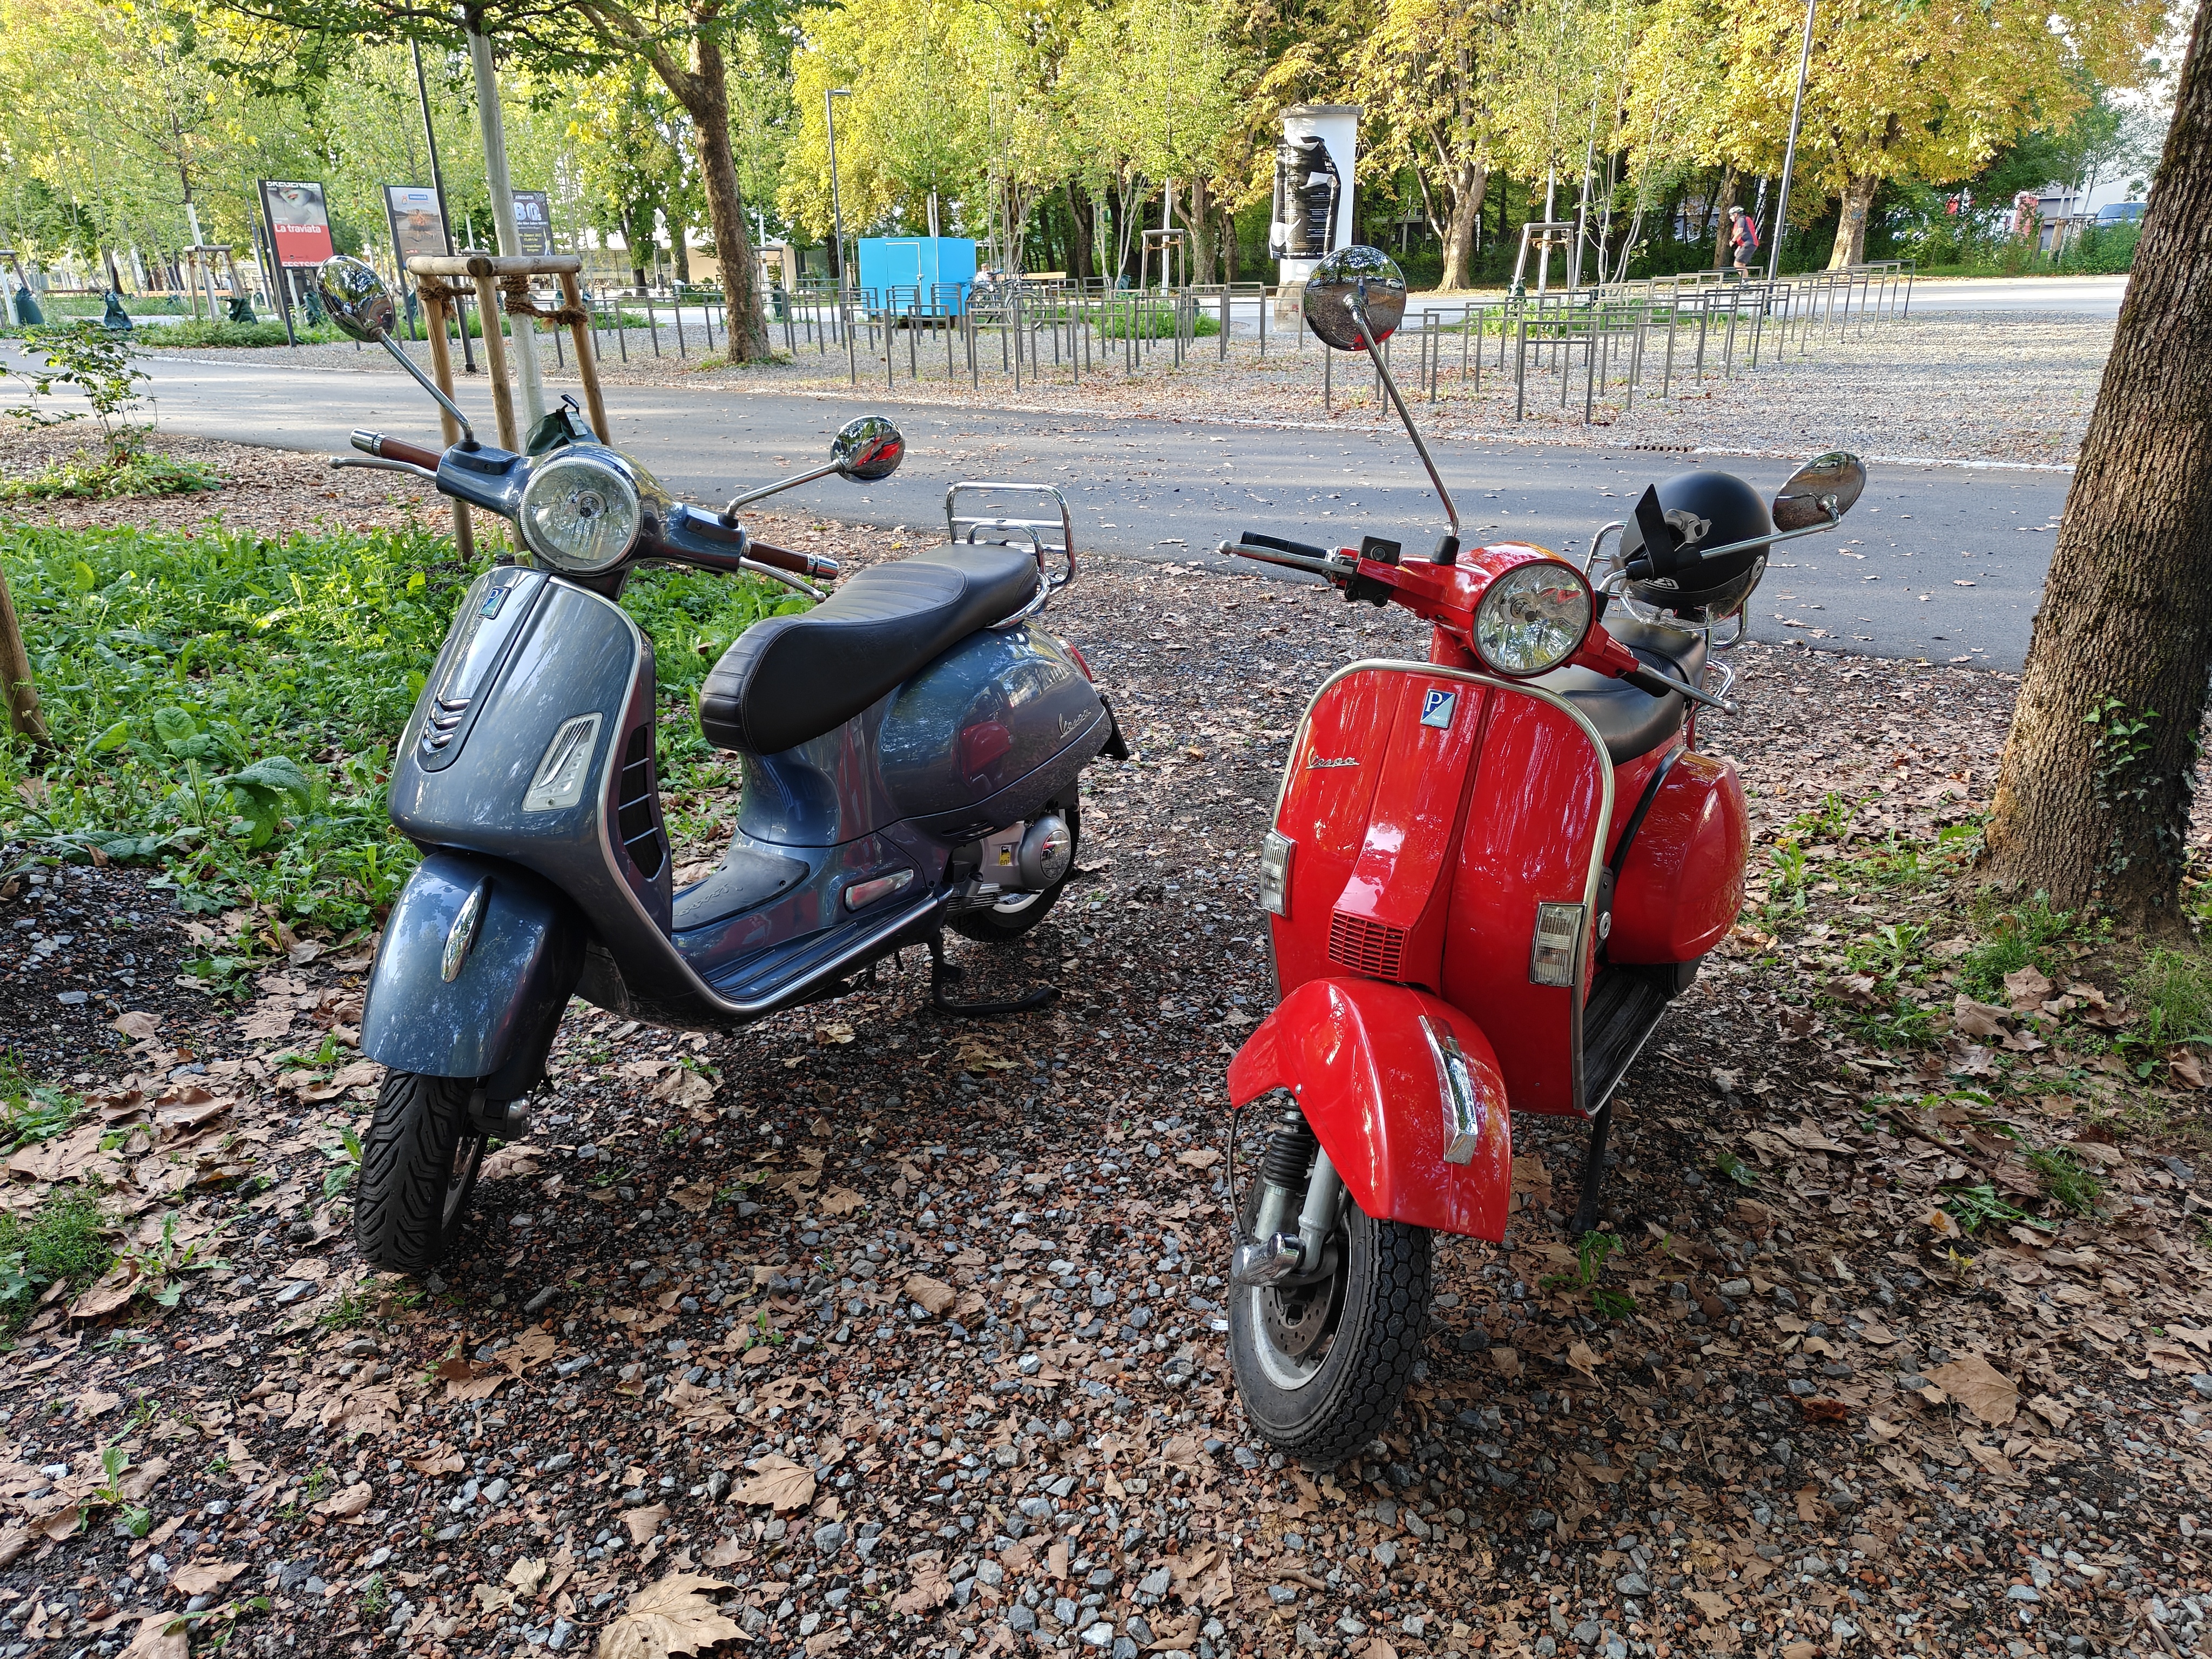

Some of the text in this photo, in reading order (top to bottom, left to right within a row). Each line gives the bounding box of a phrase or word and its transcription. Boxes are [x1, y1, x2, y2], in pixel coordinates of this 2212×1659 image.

[274, 224, 321, 233] La traviata
[485, 589, 499, 605] P
[1425, 692, 1443, 712] P
[1059, 709, 1091, 740] Vespa
[1305, 744, 1360, 770] Vespa
[1000, 857, 1010, 865] eni
